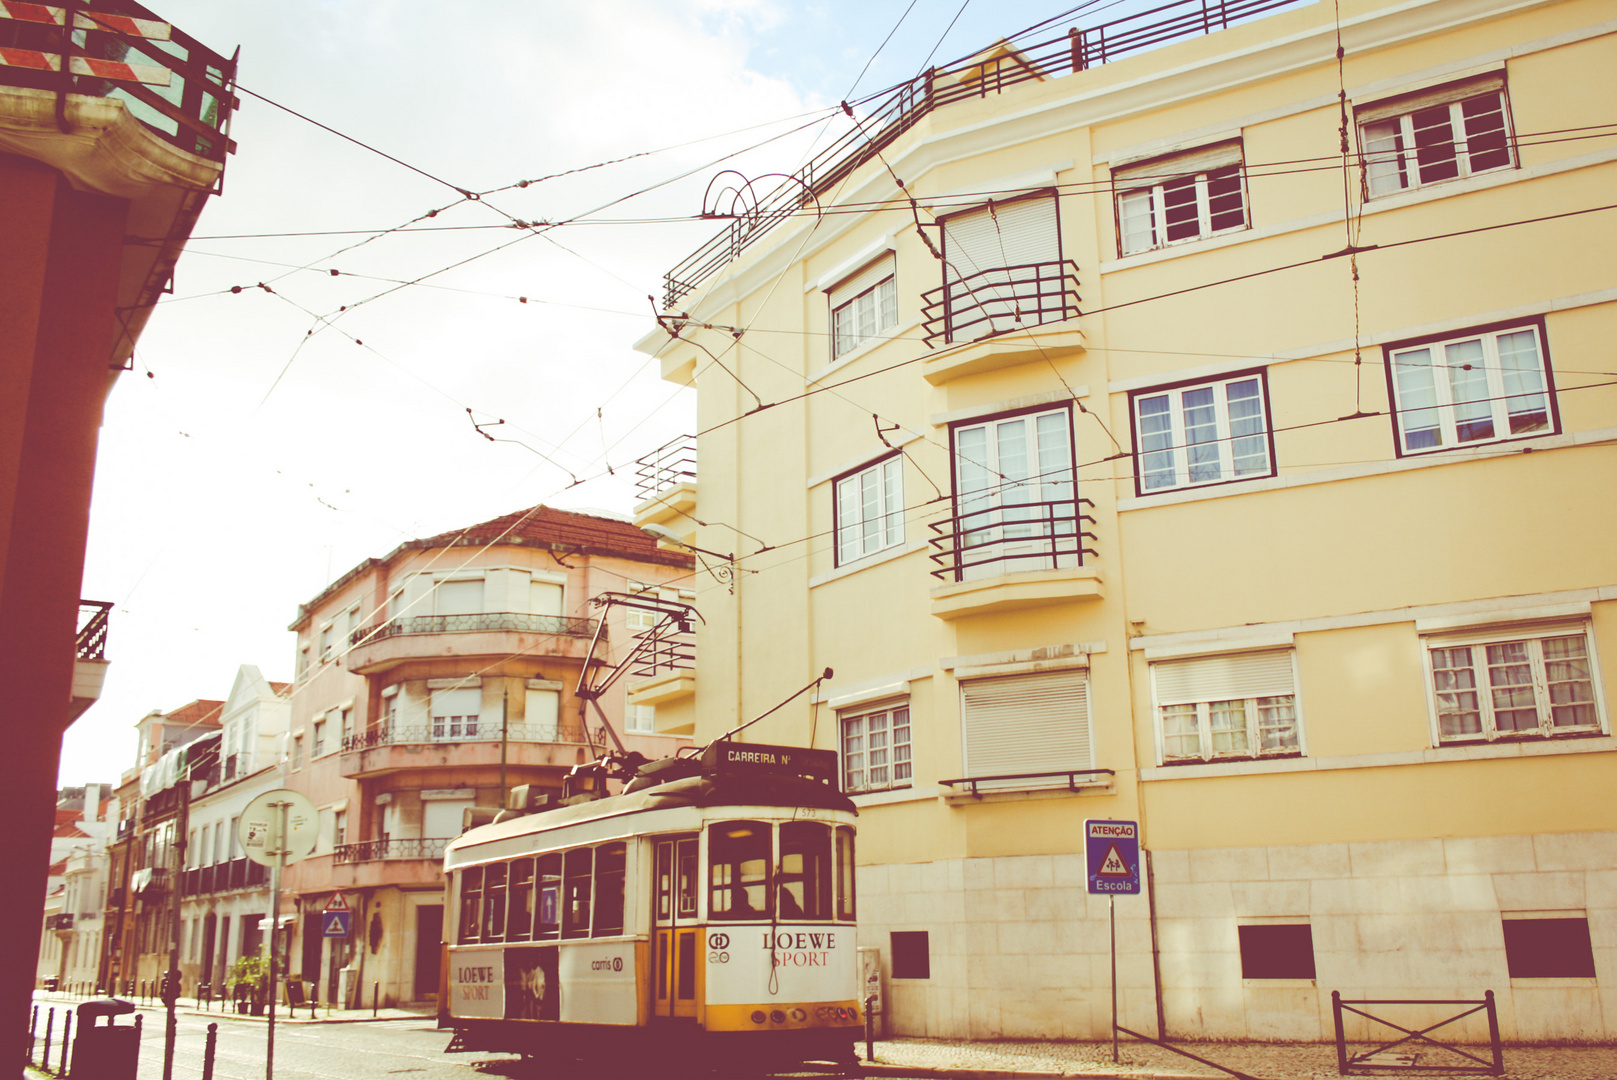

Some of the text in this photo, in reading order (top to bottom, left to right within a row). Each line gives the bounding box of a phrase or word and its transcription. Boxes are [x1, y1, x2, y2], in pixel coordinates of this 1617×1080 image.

[728, 751, 776, 764] CARREIRA
[802, 808, 816, 817] 573
[1091, 826, 1133, 836] ATENÇÃO
[1096, 880, 1132, 890] Escola
[762, 933, 835, 949] LOEWE
[591, 957, 612, 971] carris
[773, 951, 829, 967] SPORT
[458, 966, 494, 984] LOEWE
[462, 985, 490, 1000] SPORT
